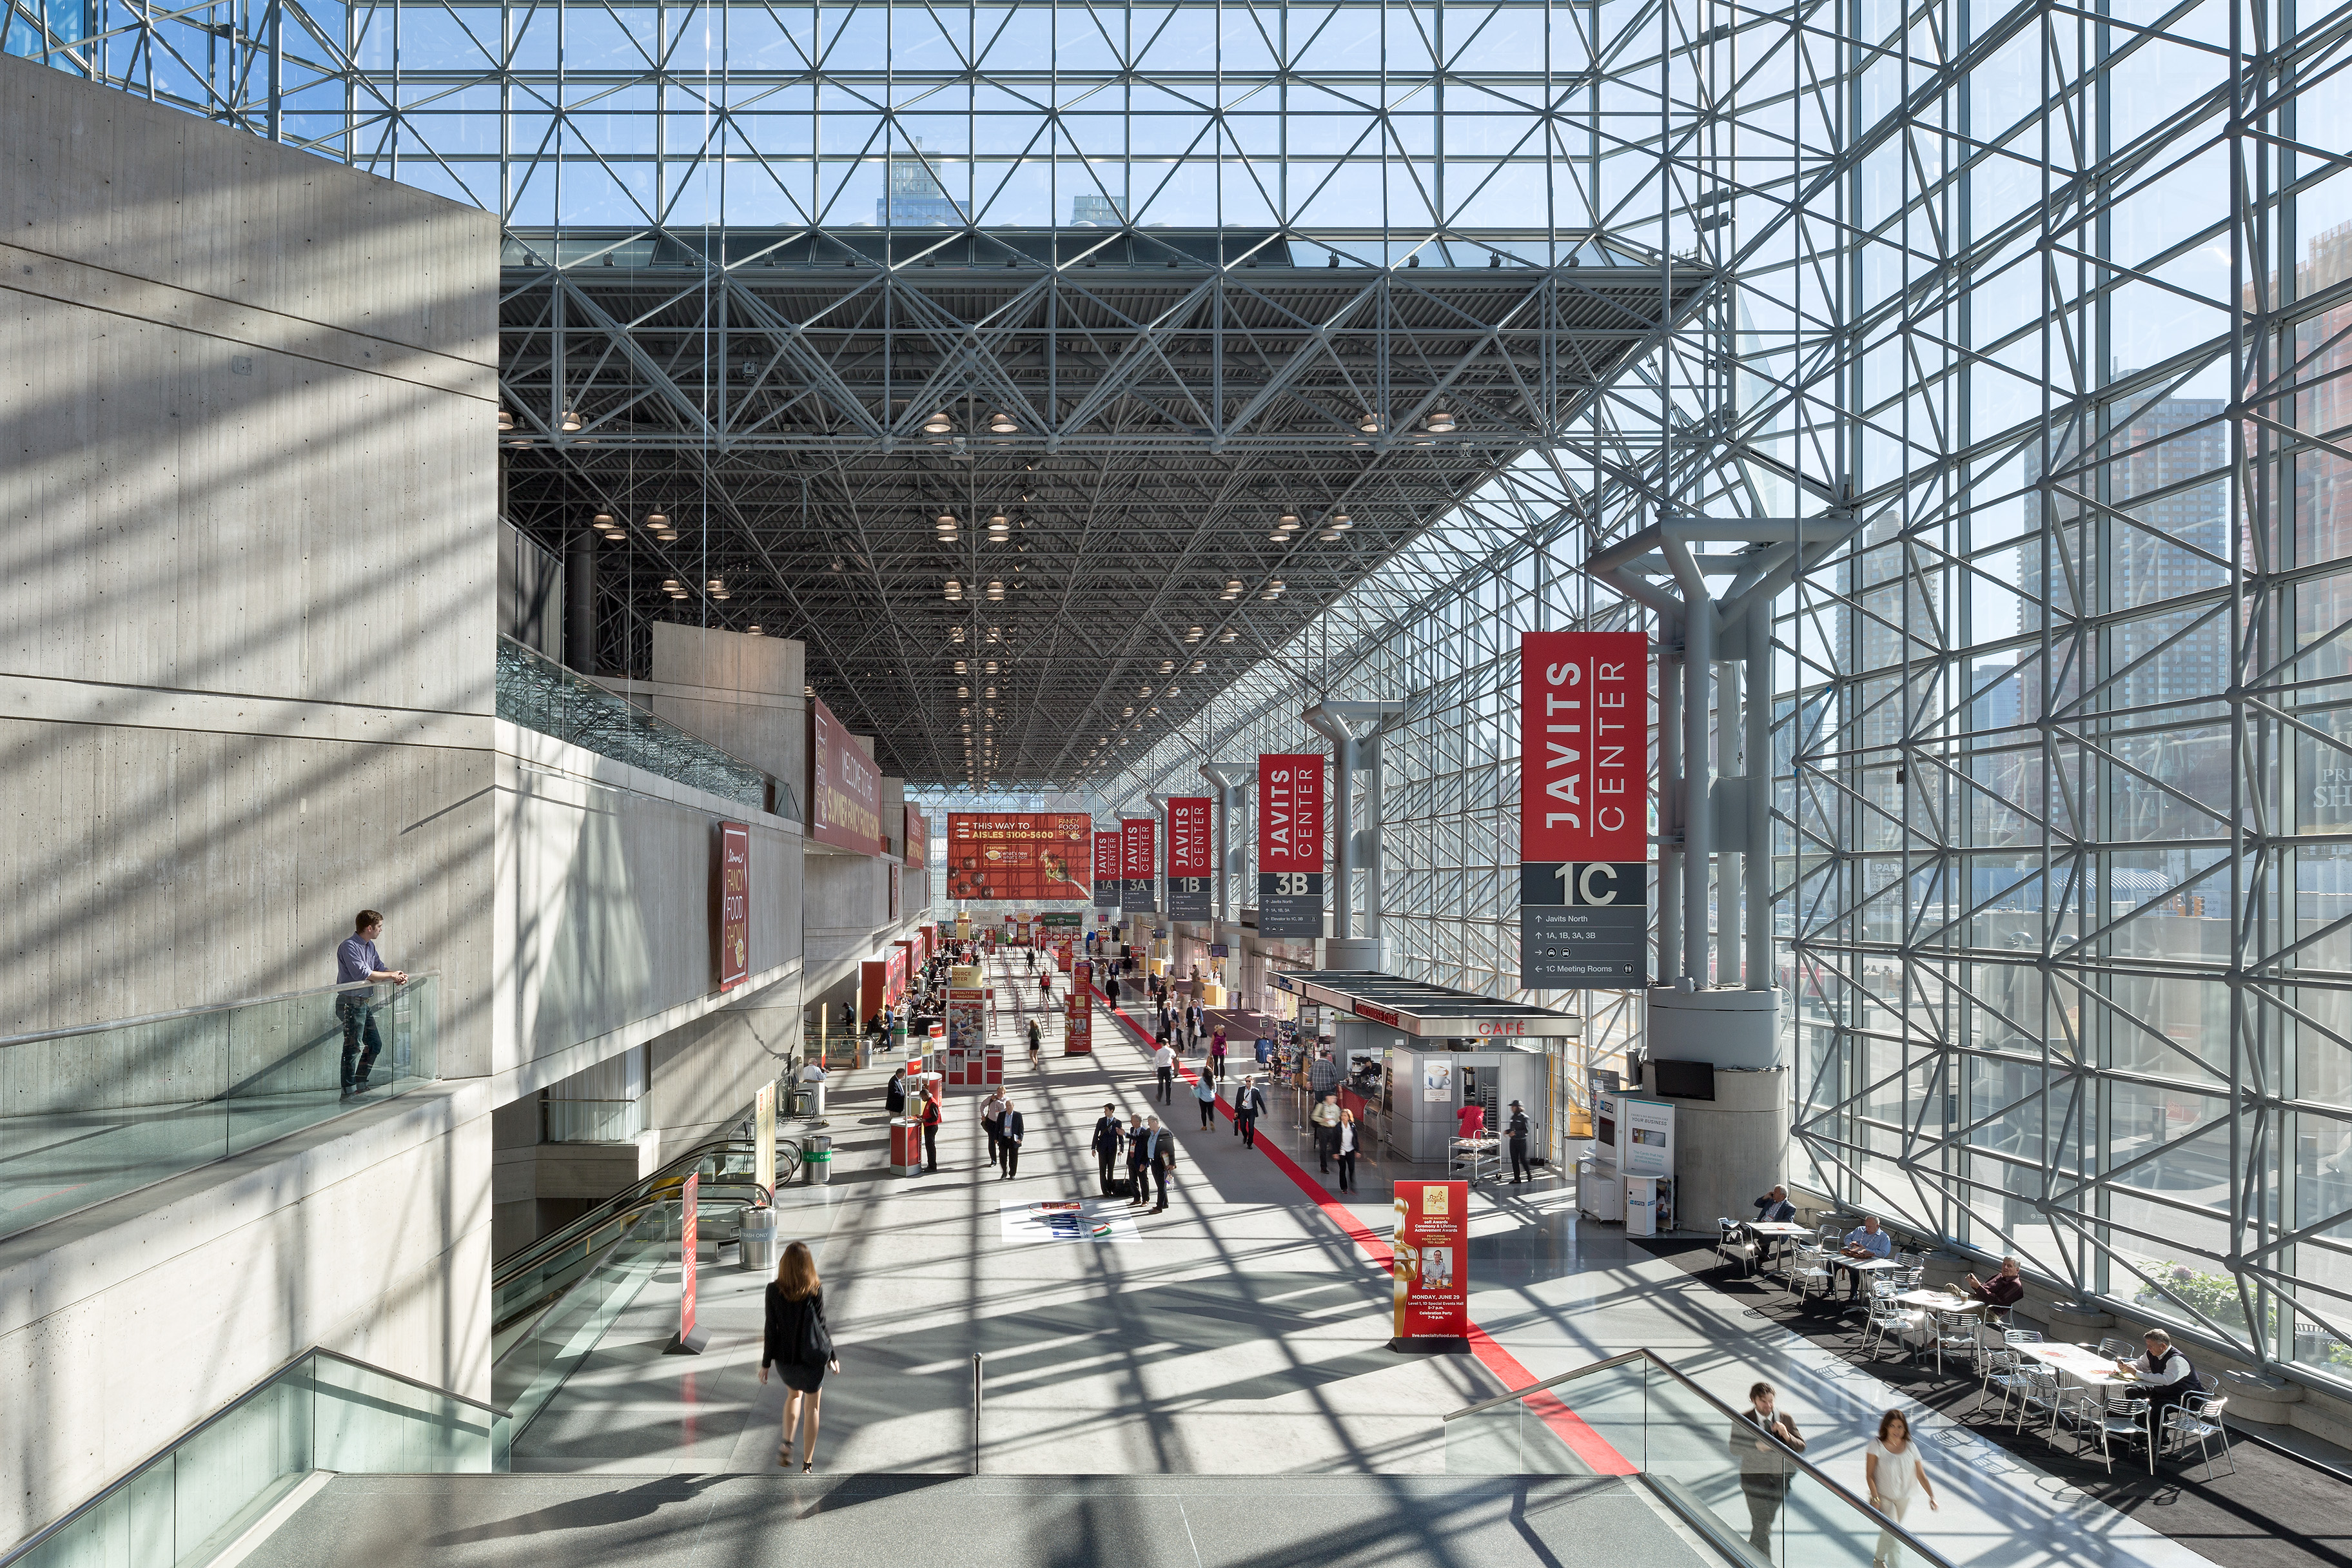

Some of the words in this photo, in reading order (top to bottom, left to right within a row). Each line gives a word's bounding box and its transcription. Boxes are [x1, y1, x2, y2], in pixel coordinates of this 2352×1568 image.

[1546, 662, 1582, 829] JAVITS
[1598, 662, 1625, 832] CENTER
[841, 747, 861, 793] WELCOME
[861, 767, 865, 797] TO
[828, 786, 848, 828] SUMMER
[848, 799, 860, 833] FANCY
[861, 807, 870, 838] FOOD
[870, 813, 879, 842] SHOW
[1271, 770, 1289, 856] JAVITS
[1298, 769, 1313, 858] CENTER
[1128, 827, 1137, 871] JAVITS
[1141, 827, 1150, 872] CENTER
[1176, 807, 1188, 866] JAVITS
[1194, 806, 1204, 867] CENTER
[727, 869, 743, 892] FANCY
[1101, 880, 1113, 890] 1A
[1130, 879, 1148, 891] 3A
[1180, 877, 1200, 892] 1B
[1275, 873, 1308, 895] 3B
[1554, 863, 1618, 905] 1C
[727, 896, 743, 921] FOOD
[727, 923, 744, 949] SHOW
[1356, 1004, 1384, 1021] CONCOURSE
[1478, 1020, 1525, 1035] CAFÉ
